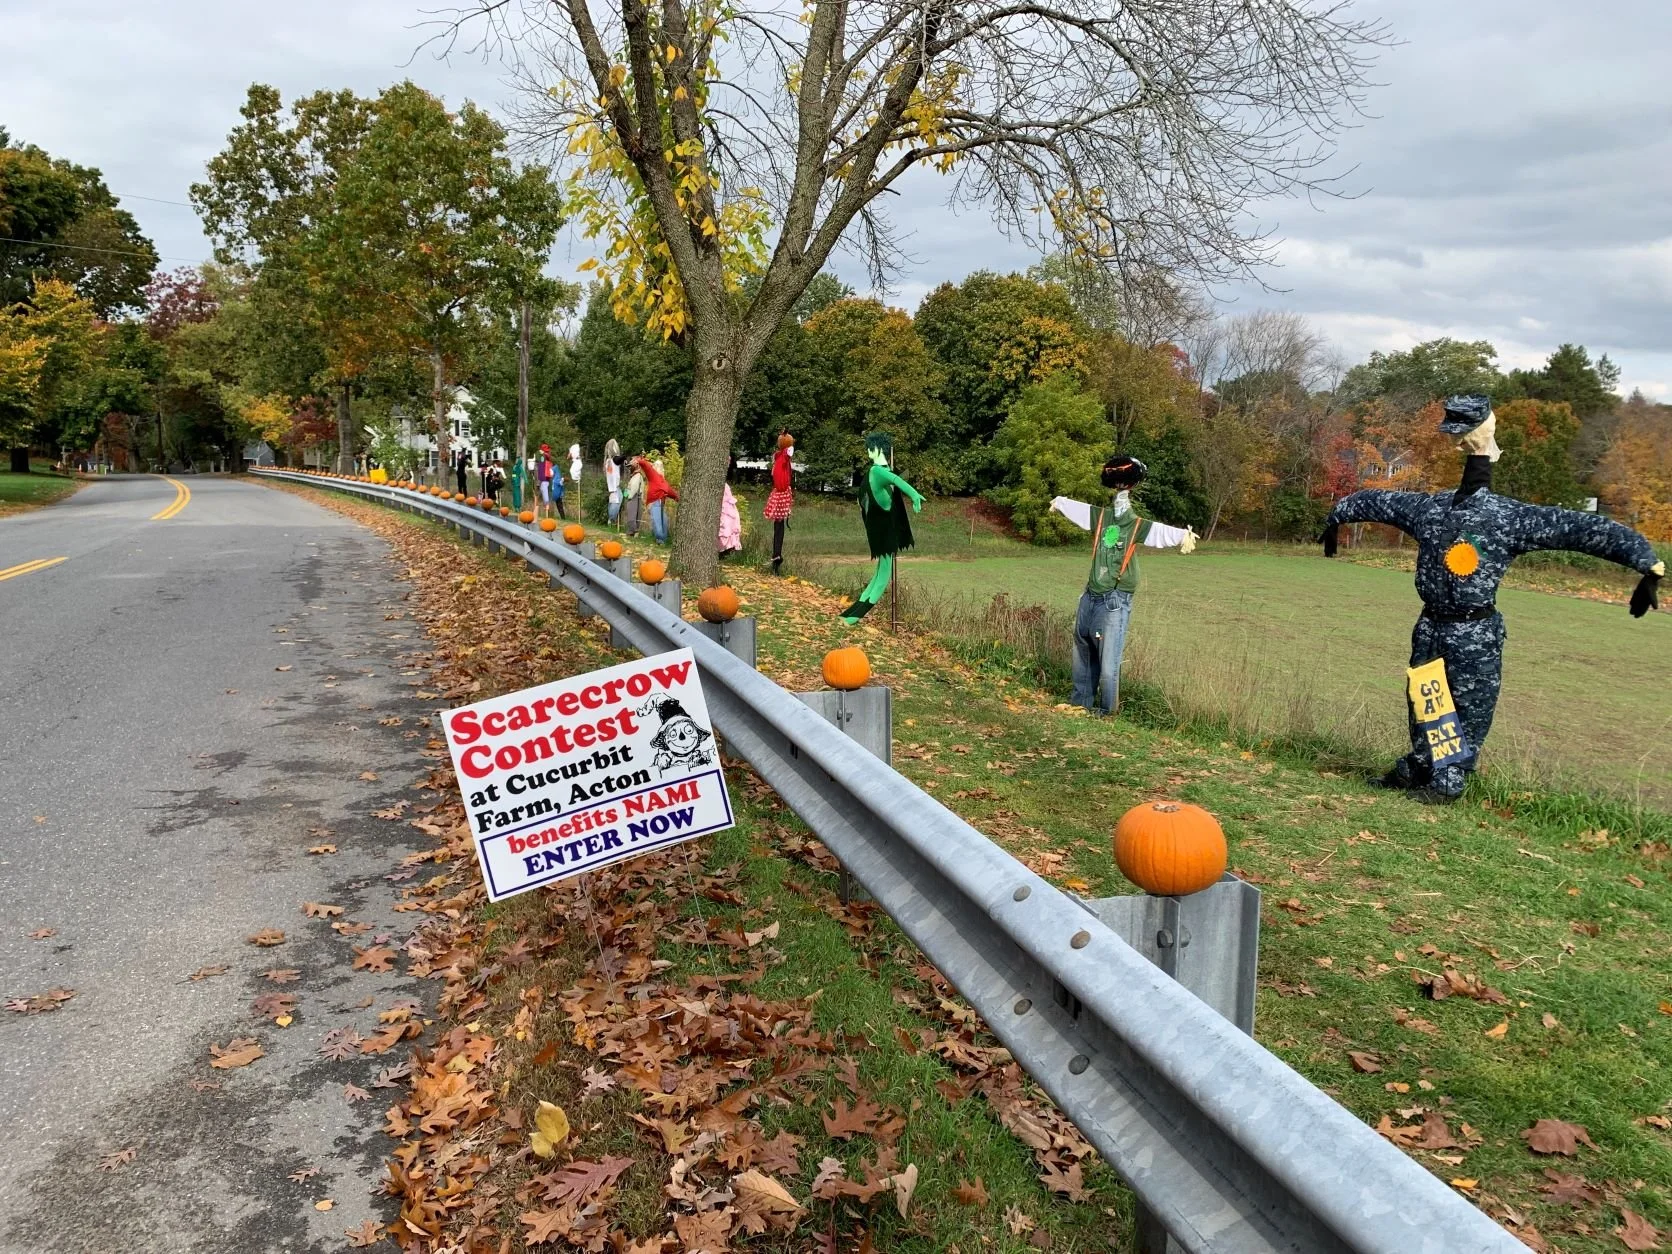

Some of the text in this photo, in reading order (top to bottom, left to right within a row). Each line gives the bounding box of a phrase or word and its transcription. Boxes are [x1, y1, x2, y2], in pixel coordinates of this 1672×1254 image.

[450, 661, 692, 745] Scarecrow
[1421, 680, 1441, 697] GO
[460, 707, 639, 778] Contest
[470, 744, 633, 807] at Cucurbit
[476, 769, 651, 833] Farm, Acton
[506, 780, 701, 854] benefits NAMI
[523, 807, 694, 876] ENTER NOW
